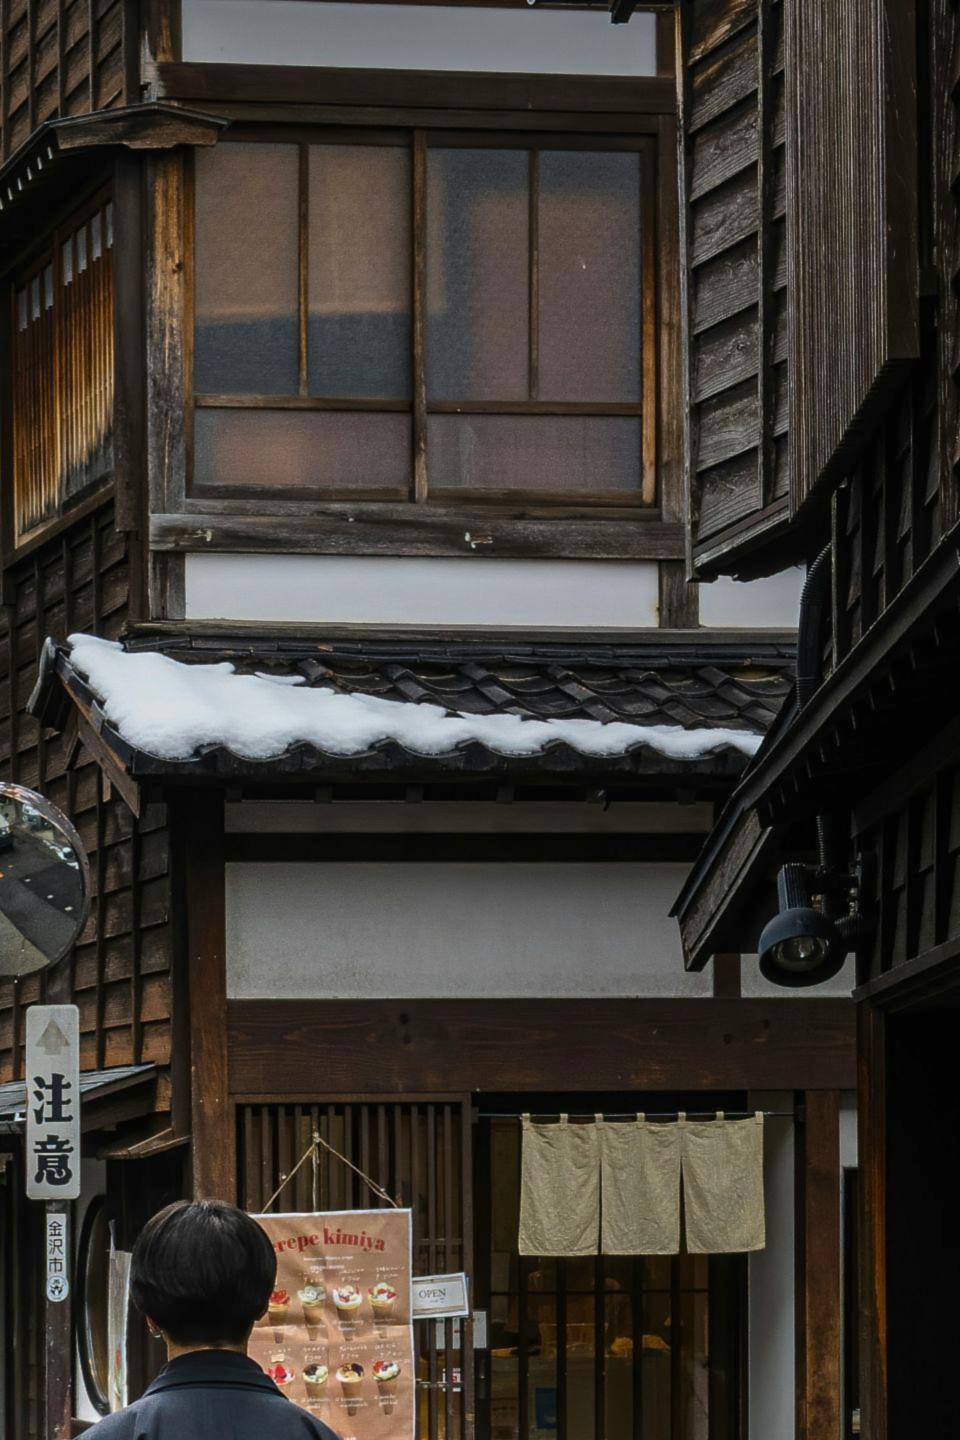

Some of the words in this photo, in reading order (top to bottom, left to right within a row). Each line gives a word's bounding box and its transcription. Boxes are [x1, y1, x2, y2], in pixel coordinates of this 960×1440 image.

[33, 1072, 74, 1186] 注意
[48, 1220, 64, 1273] 金沢市
[273, 1233, 320, 1253] repe
[323, 1228, 386, 1252] kimiya
[418, 1287, 447, 1299] OPEN
